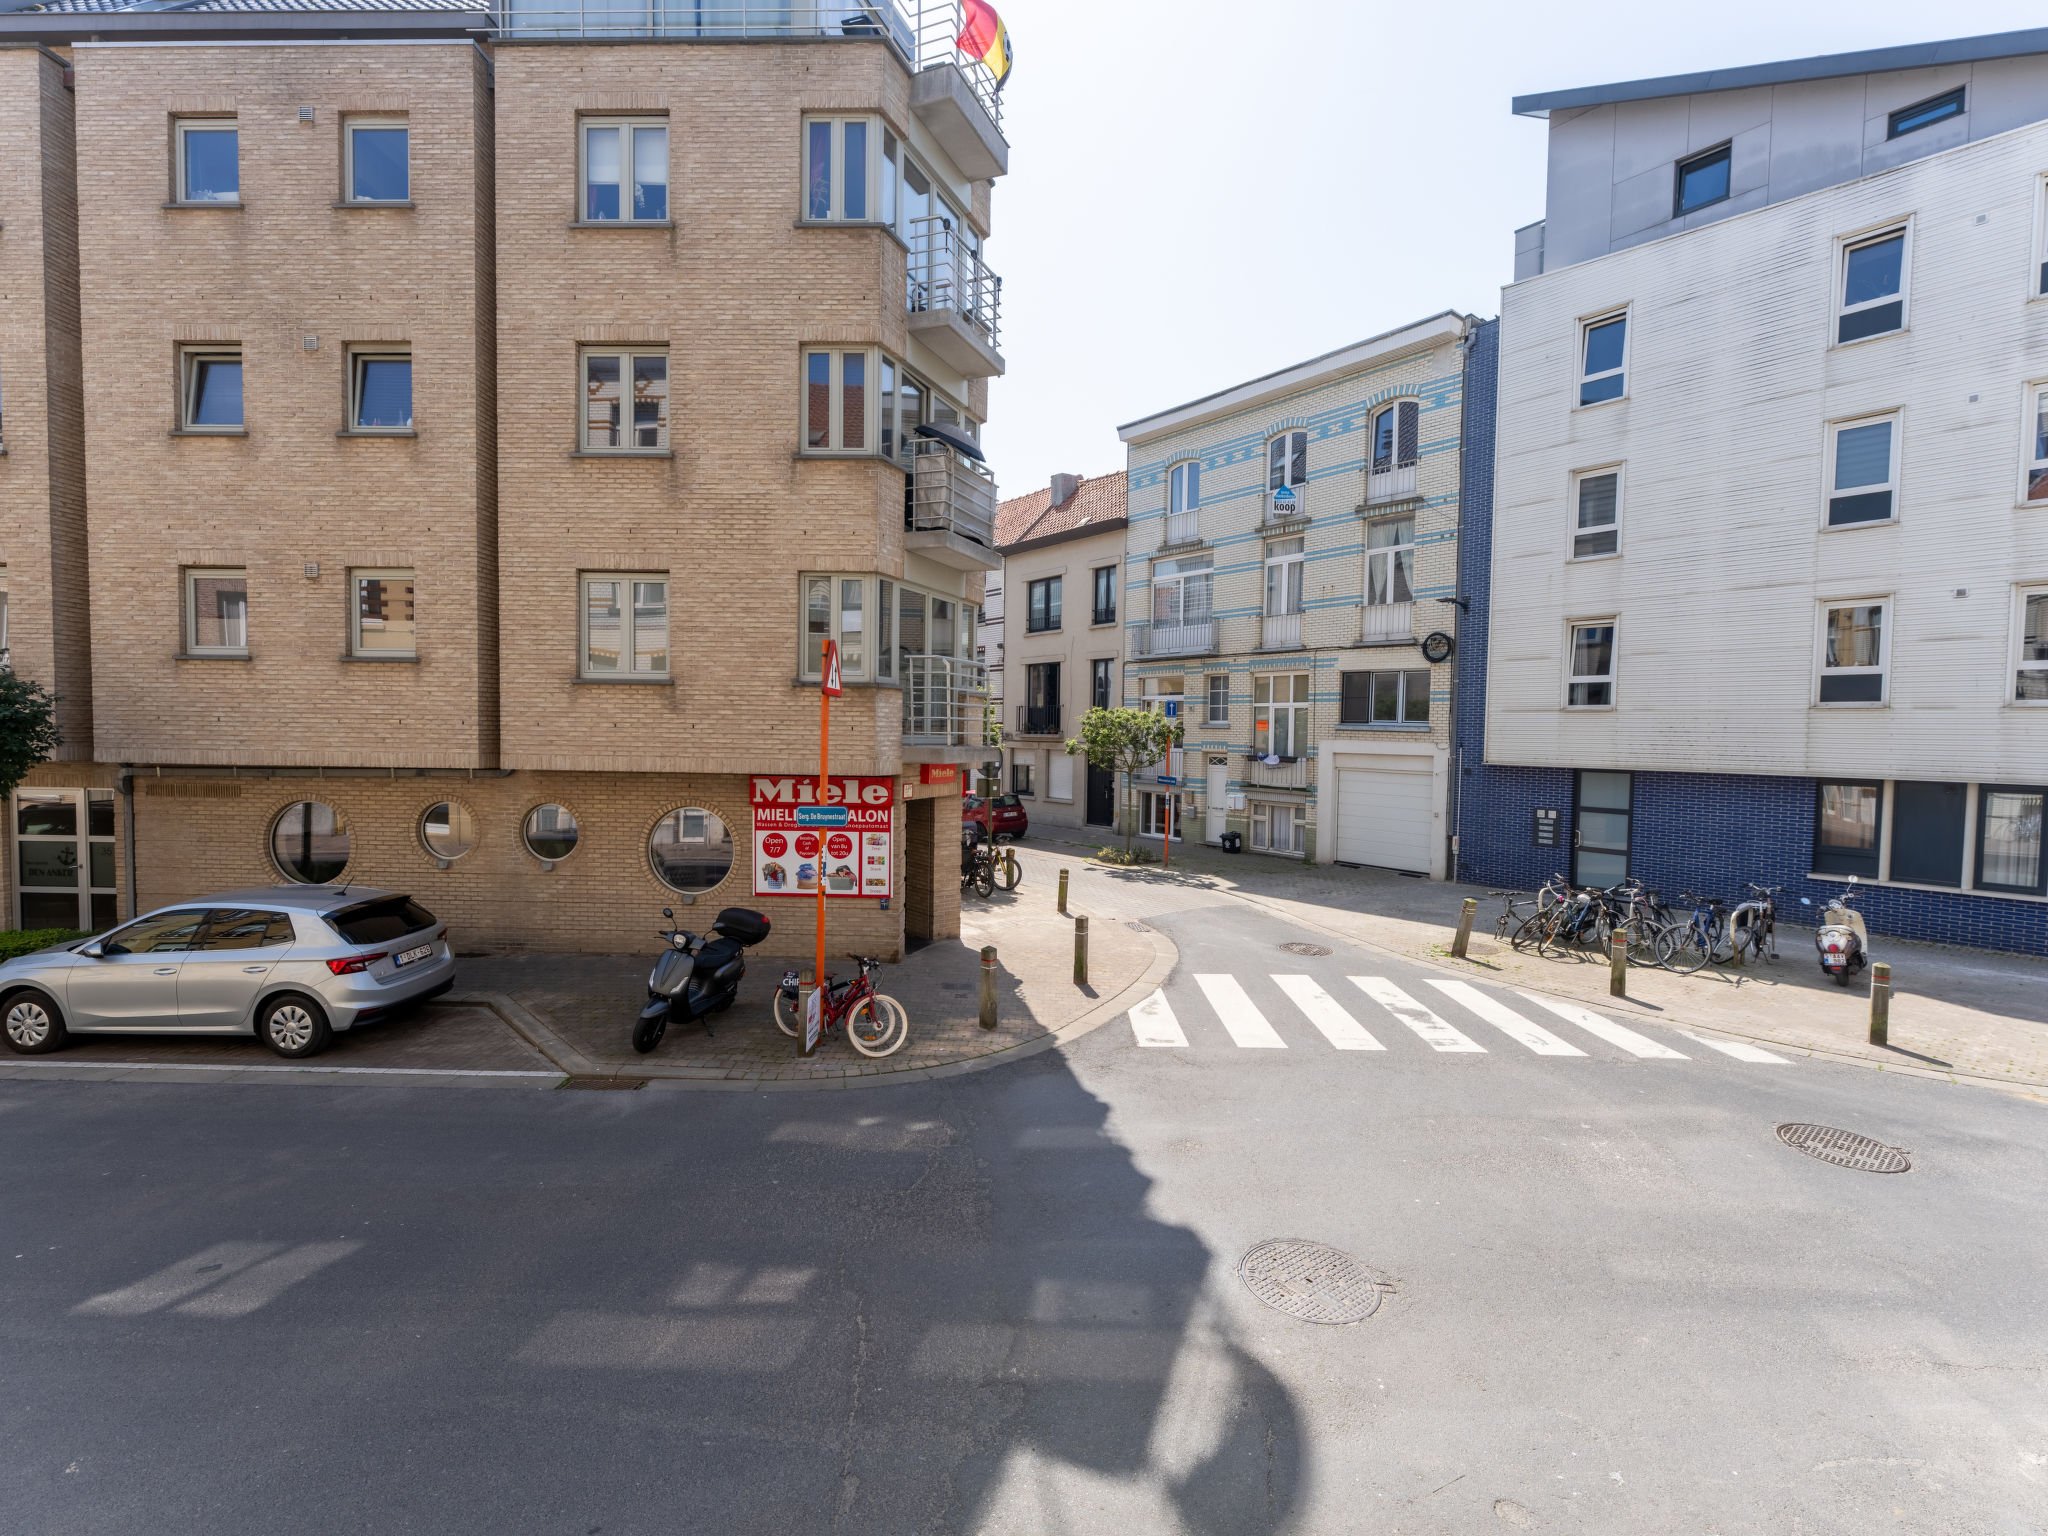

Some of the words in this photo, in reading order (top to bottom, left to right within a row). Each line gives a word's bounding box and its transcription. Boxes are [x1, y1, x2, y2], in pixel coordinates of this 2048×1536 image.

[1274, 500, 1296, 514] koop
[931, 768, 954, 778] Miele
[753, 779, 889, 805] Miele
[810, 812, 817, 820] De
[847, 809, 889, 823] ALON
[765, 836, 784, 845] Open
[832, 836, 847, 844] Open
[769, 846, 781, 854] 7/7
